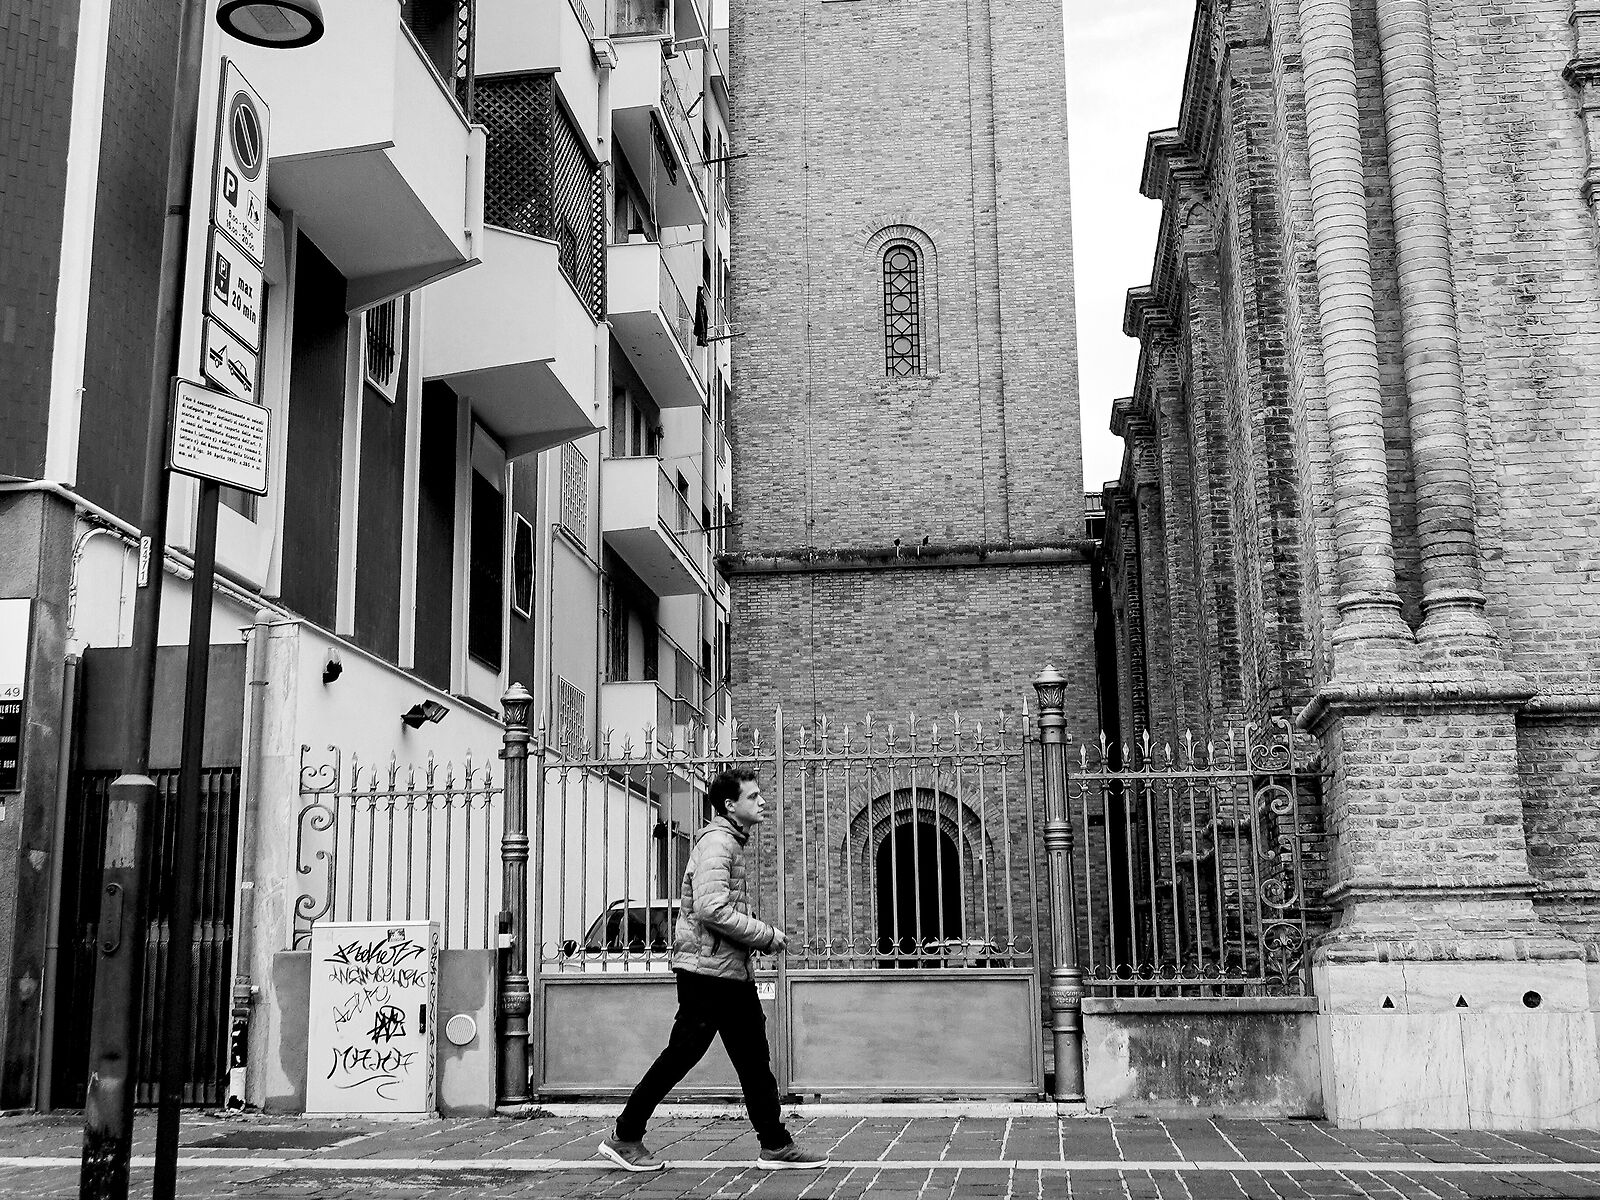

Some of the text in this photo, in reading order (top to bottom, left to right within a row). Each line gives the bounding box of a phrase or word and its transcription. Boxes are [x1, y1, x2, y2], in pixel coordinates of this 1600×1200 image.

[225, 172, 236, 197] P
[238, 277, 253, 299] max
[232, 291, 257, 325] 20 min
[4, 687, 20, 698] 49
